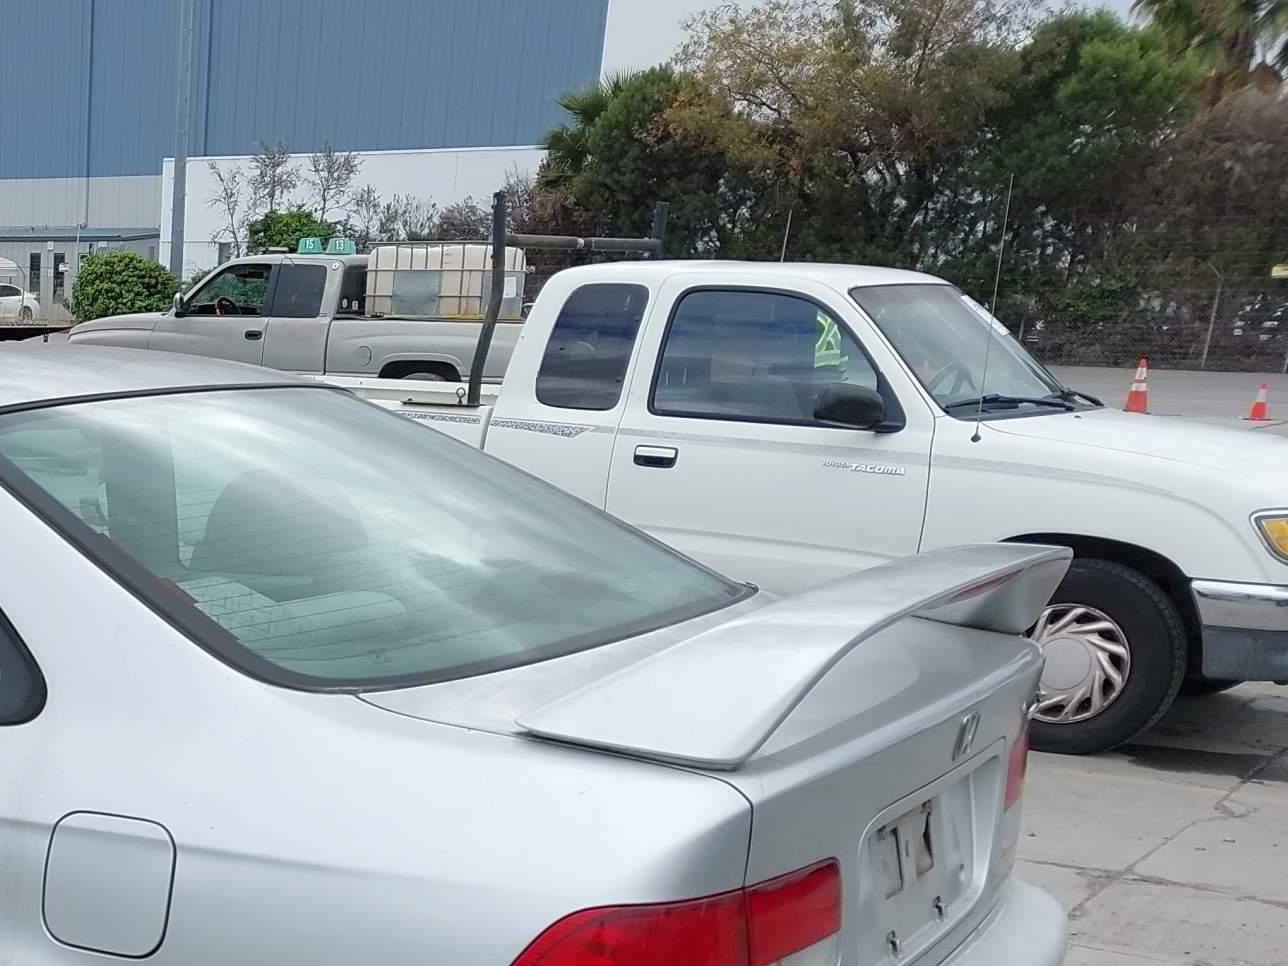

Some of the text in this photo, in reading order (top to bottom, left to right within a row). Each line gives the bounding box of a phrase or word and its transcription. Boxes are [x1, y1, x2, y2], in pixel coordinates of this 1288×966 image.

[305, 239, 314, 249] 15
[335, 239, 344, 250] 13
[849, 463, 905, 475] TACOMA
